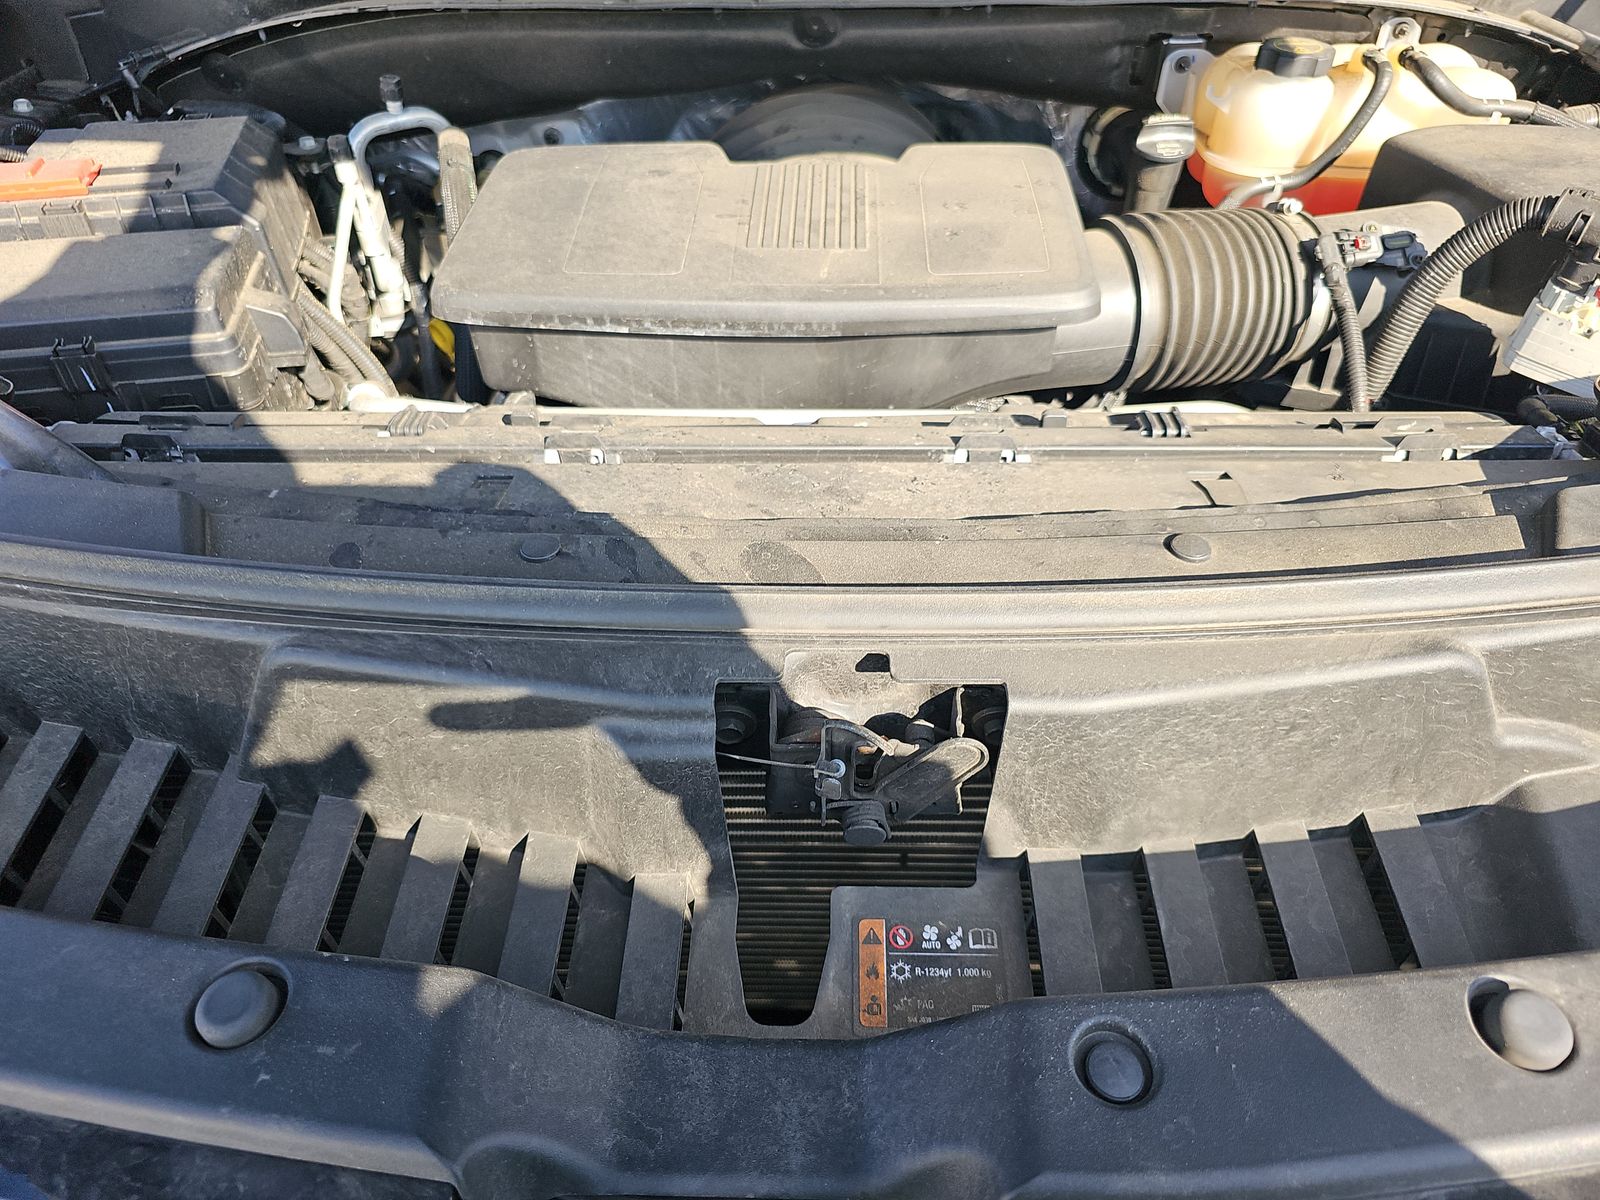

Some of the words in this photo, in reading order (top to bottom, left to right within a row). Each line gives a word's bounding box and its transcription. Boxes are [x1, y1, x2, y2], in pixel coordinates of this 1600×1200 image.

[922, 940, 942, 949] AUTO
[957, 968, 980, 977] 1.000
[981, 968, 992, 978] kg
